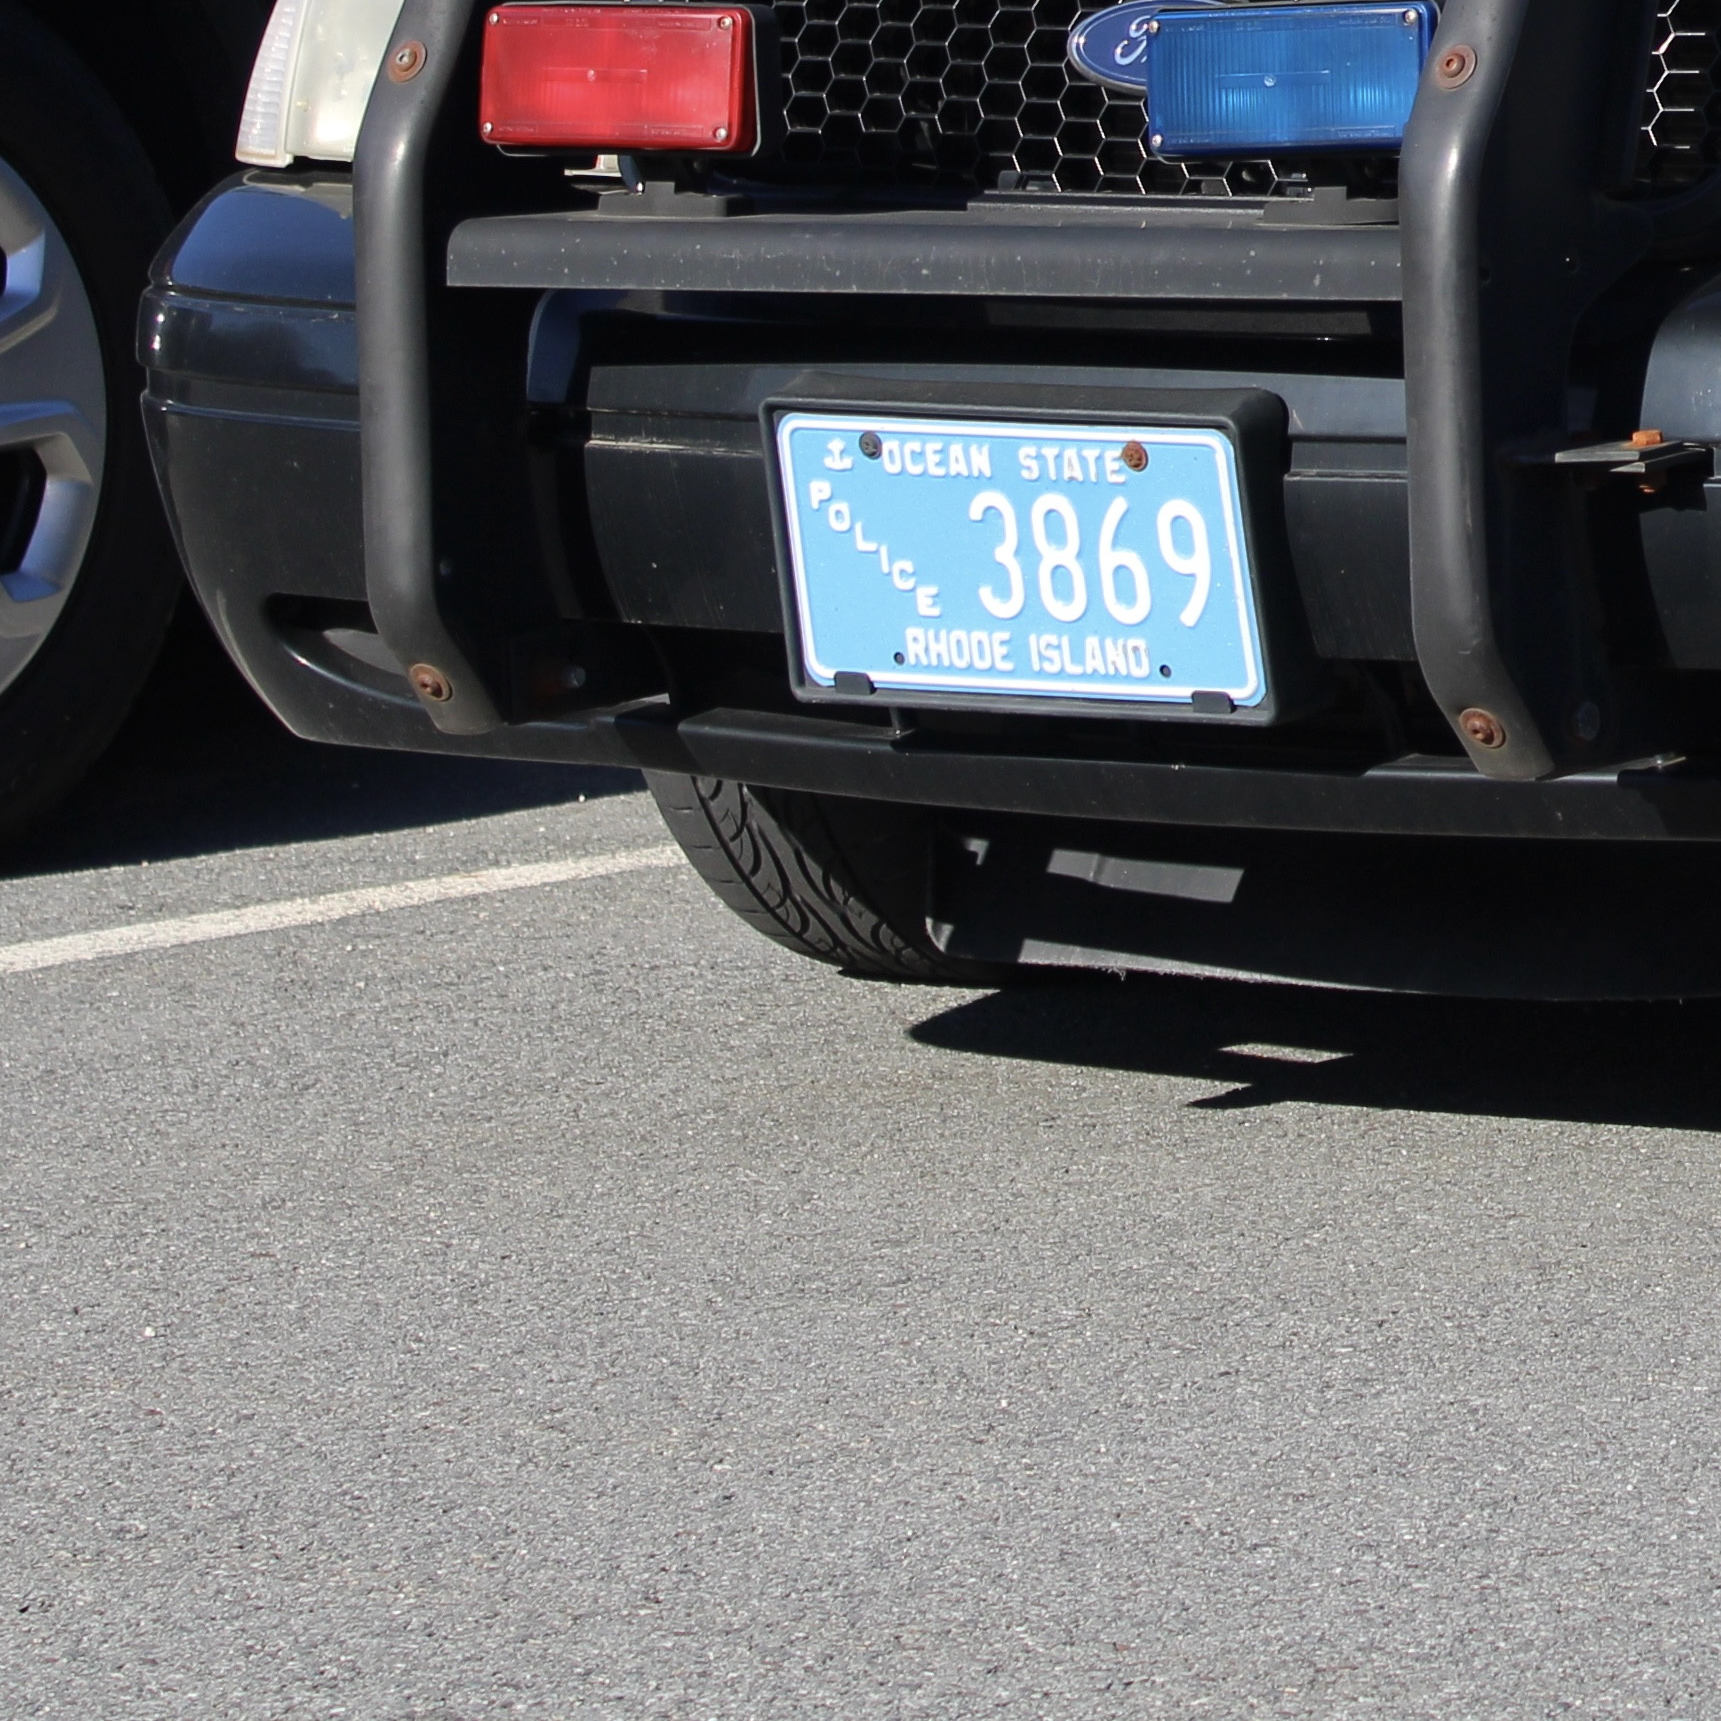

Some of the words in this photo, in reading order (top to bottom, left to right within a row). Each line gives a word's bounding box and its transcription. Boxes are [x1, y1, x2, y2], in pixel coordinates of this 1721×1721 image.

[882, 440, 992, 479] OCEAN
[1018, 446, 1127, 484] STATE
[808, 479, 941, 618] POLICE
[967, 489, 1214, 629] 3869
[905, 628, 1015, 672] RHODE
[1029, 632, 1151, 679] ISLAND
